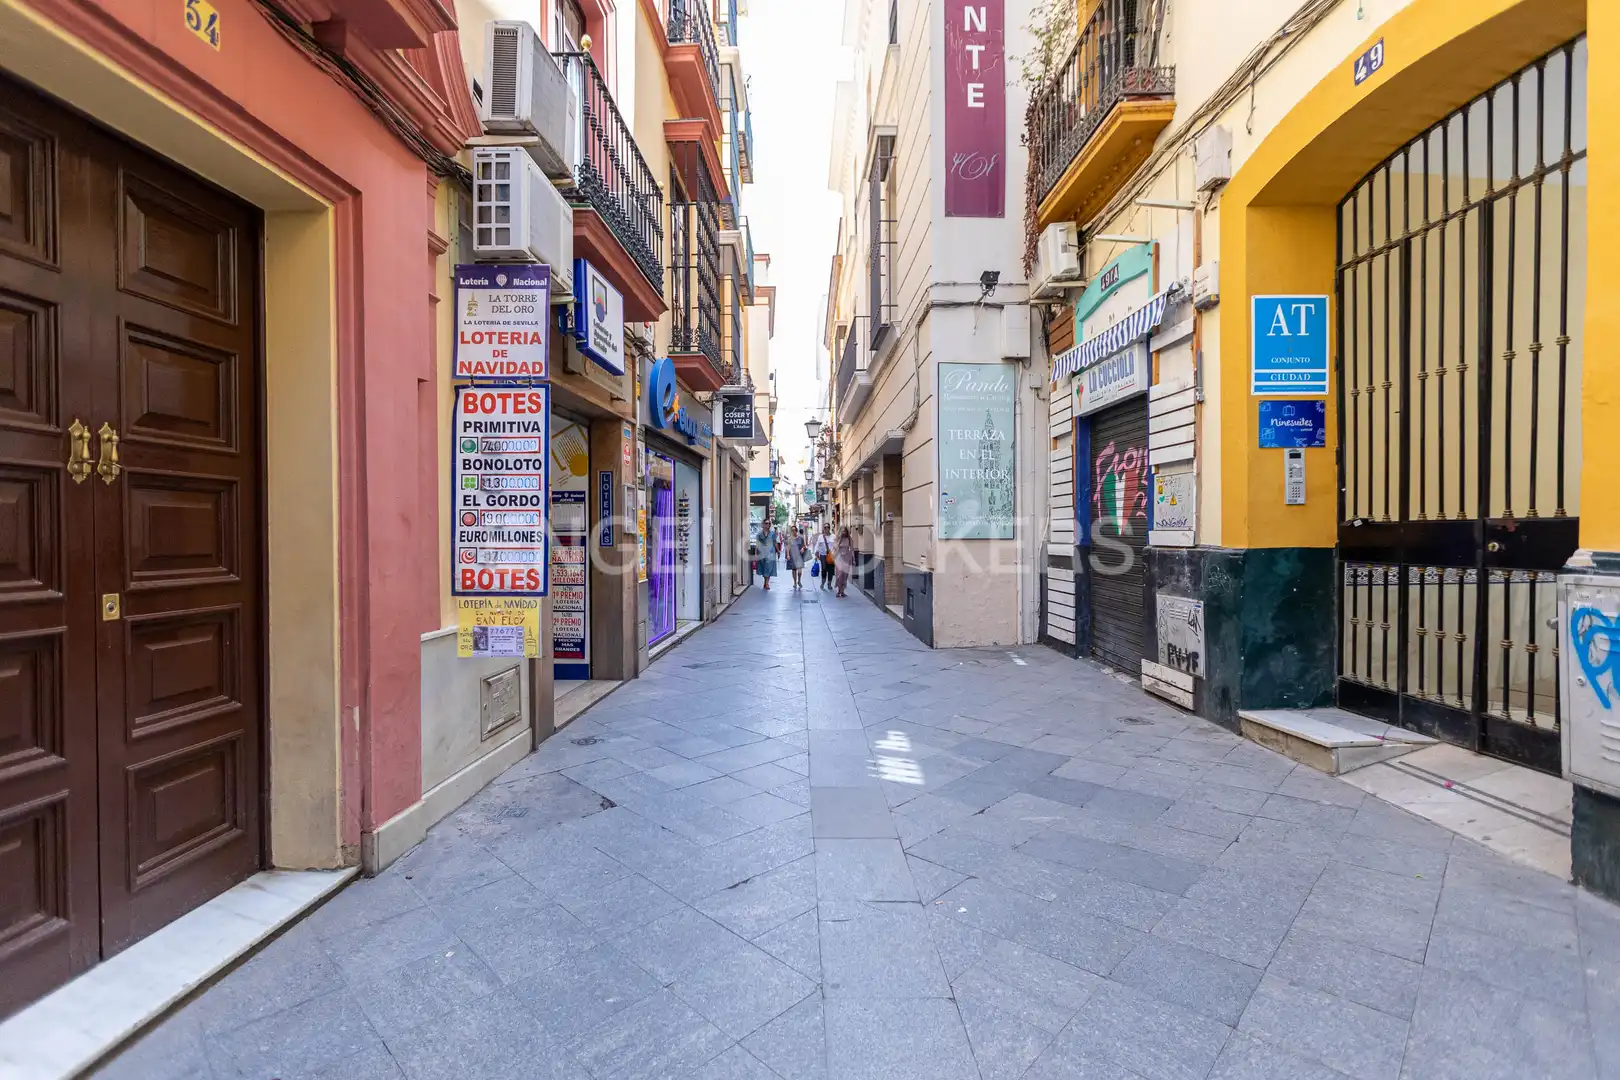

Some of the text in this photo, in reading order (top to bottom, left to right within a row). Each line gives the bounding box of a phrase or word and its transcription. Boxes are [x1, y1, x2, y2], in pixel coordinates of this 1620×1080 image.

[187, 0, 219, 46] 54
[1355, 43, 1383, 81] 49
[460, 277, 548, 286] Lotería Nacional
[489, 294, 537, 302] LA TORRE
[491, 305, 534, 313] DEL ORO
[1267, 304, 1316, 336] AT
[460, 331, 542, 345] LOTERIA
[492, 350, 508, 358] DE
[459, 361, 543, 375] NAVIDAD
[1088, 351, 1135, 394] LA CUCCIOLA
[944, 368, 1009, 393] Pando
[1270, 373, 1311, 381] CIUDAD
[463, 392, 542, 414] BOTES
[463, 421, 541, 433] PRIMITIVA
[1270, 416, 1313, 427] Ninesuites
[948, 429, 1006, 440] TERRAZA
[960, 449, 996, 460] EN EL
[462, 458, 542, 471] BONOLOTO
[945, 468, 1010, 480] INTERIOR
[463, 495, 540, 507] EL GORDO
[602, 474, 611, 543] LOTERIAS
[459, 530, 543, 543] EUROMILLONES
[461, 568, 541, 591] BOTES
[561, 592, 583, 600] PREMIO
[476, 616, 525, 626] SAN ELOY
[561, 618, 582, 626] PREMIO
